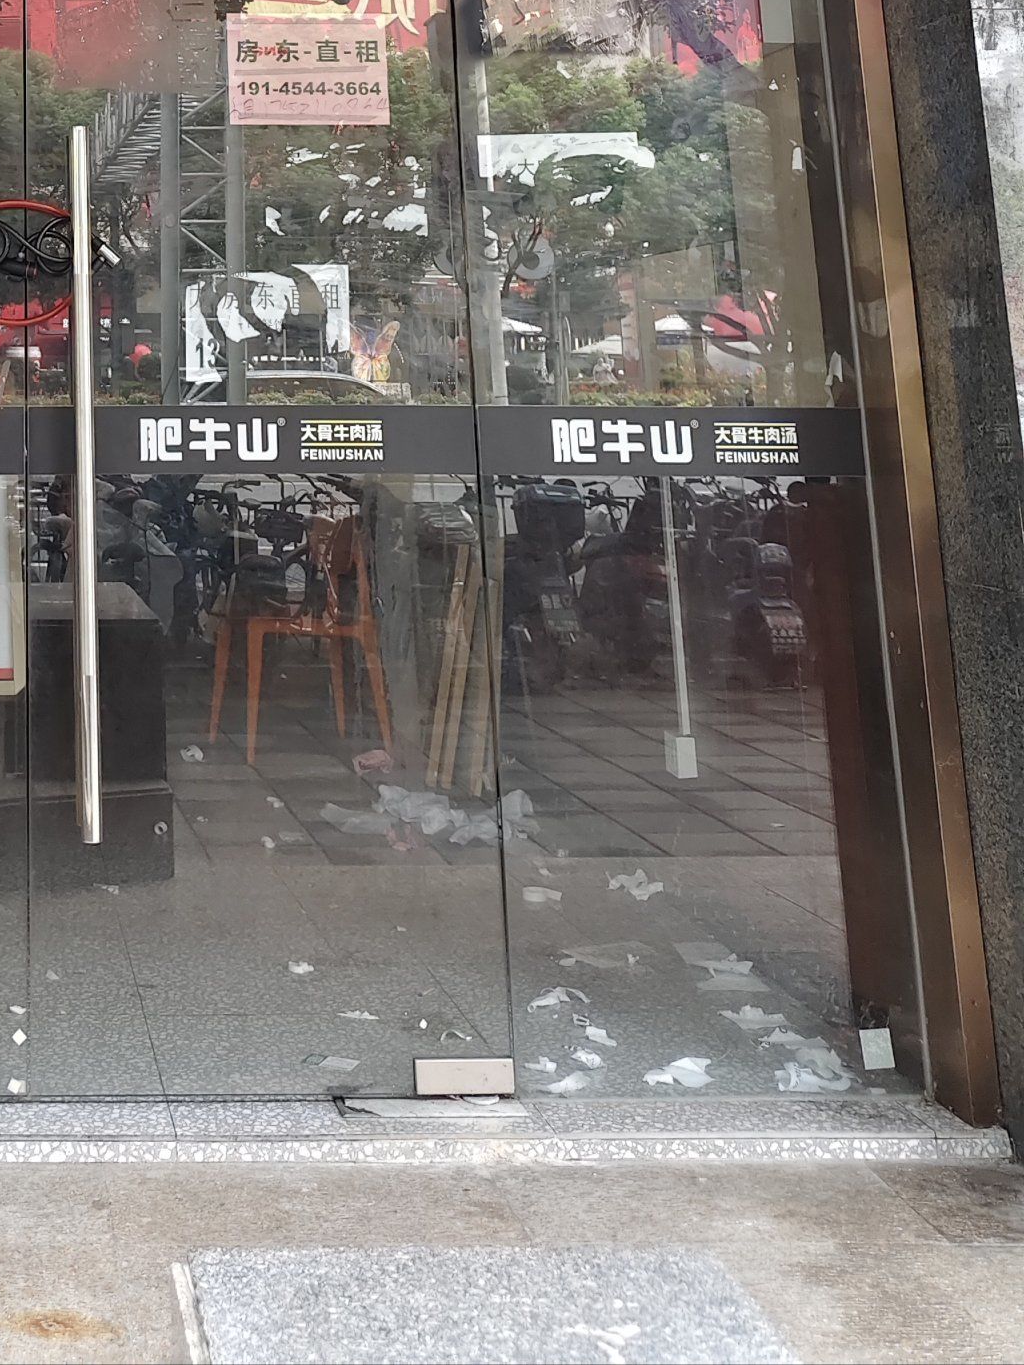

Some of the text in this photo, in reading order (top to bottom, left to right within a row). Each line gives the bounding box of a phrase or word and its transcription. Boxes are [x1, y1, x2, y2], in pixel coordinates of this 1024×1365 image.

[237, 81, 382, 96] 191-4544-3664
[139, 418, 279, 461] 肥牛山
[301, 424, 383, 442] 大骨牛肉汤
[551, 419, 694, 463] 肥牛山
[715, 427, 798, 444] 大骨牛肉汤
[301, 449, 384, 461] FEINIUSHAN
[716, 451, 799, 463] FEINIUSHAN
